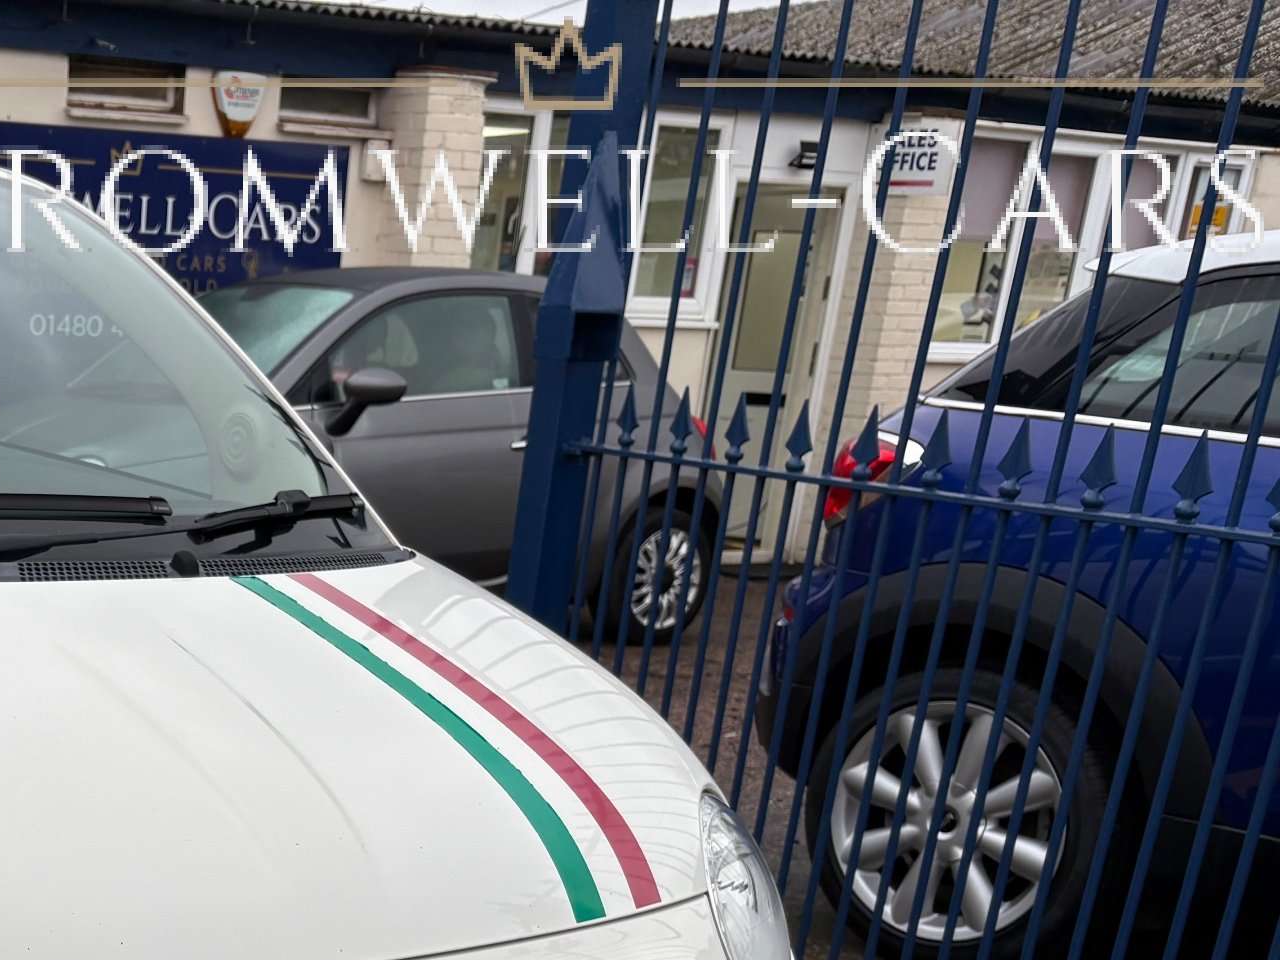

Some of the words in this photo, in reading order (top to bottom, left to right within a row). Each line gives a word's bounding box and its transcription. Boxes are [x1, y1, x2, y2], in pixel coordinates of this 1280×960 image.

[885, 128, 939, 148] ALES
[880, 151, 939, 171] FFICE
[175, 254, 227, 273] CARS
[180, 277, 218, 294] OLD
[29, 313, 104, 337] 01480
